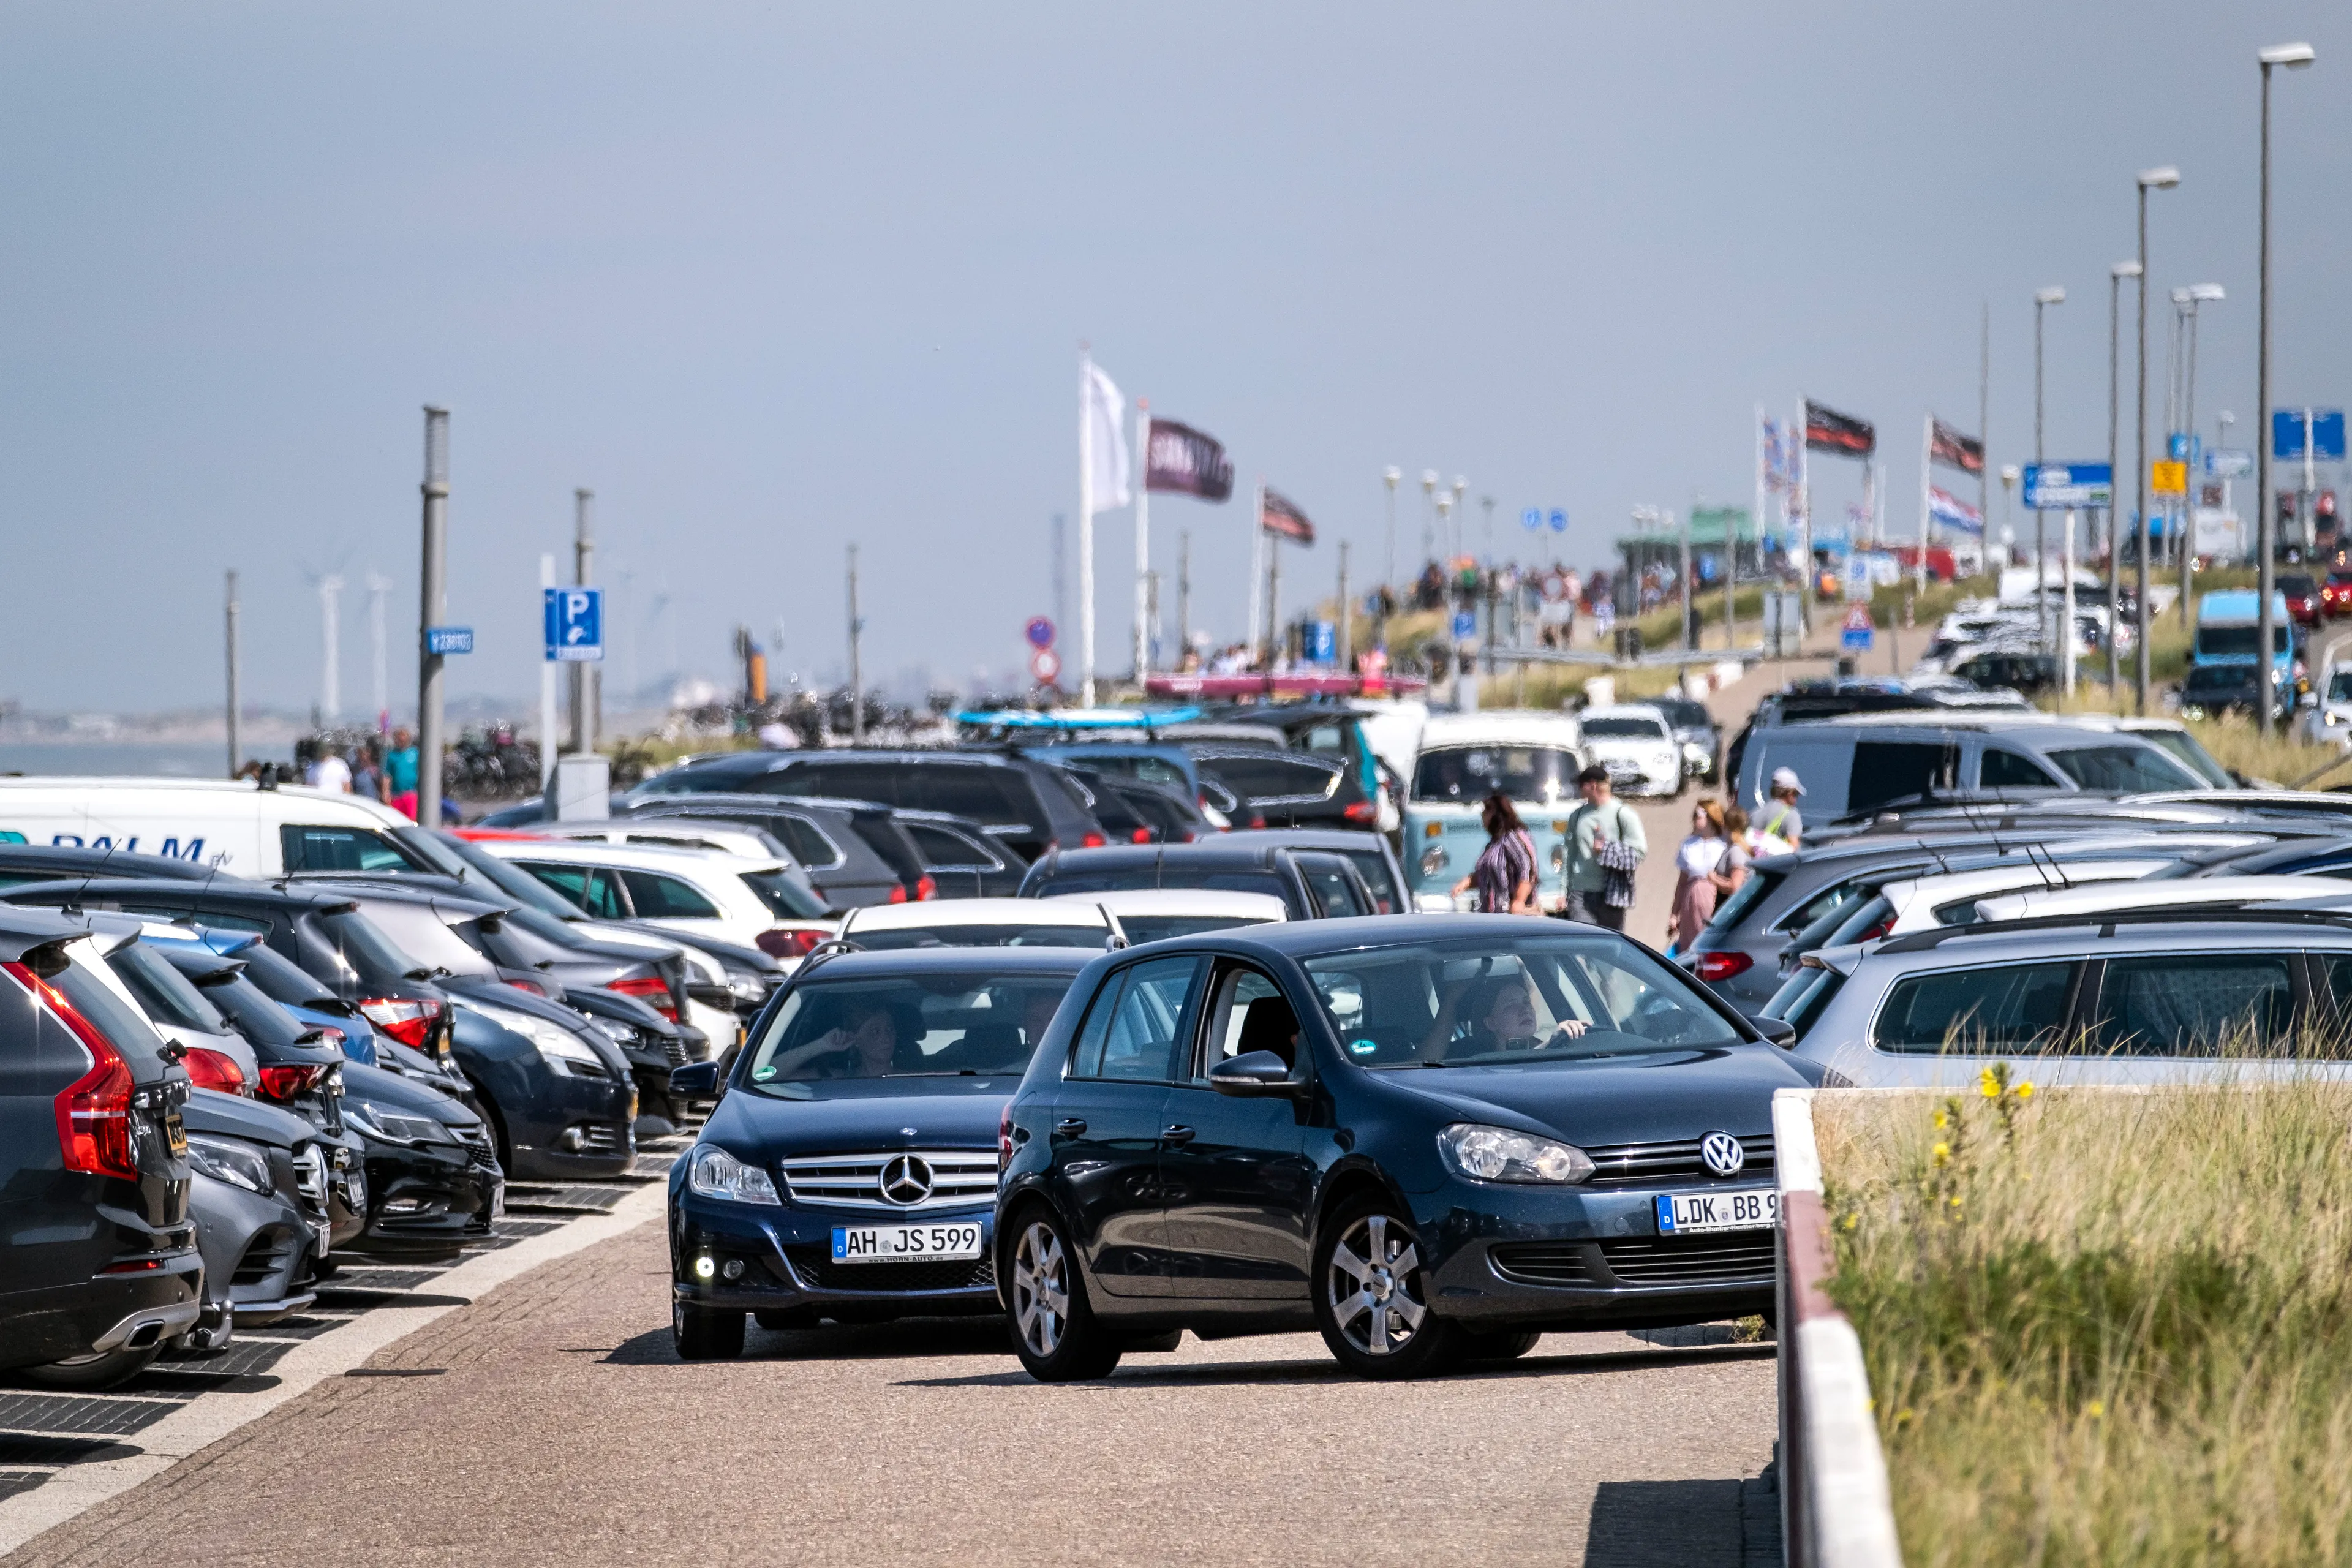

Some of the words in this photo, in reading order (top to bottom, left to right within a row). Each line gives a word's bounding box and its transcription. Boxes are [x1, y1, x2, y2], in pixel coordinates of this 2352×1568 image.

[567, 593, 589, 625] P
[1664, 1216, 1670, 1224] D
[1674, 1197, 1717, 1224] LDK
[1733, 1195, 1762, 1220] BB
[847, 1231, 876, 1254] AH
[894, 1229, 924, 1253] JS
[932, 1227, 976, 1251] 599
